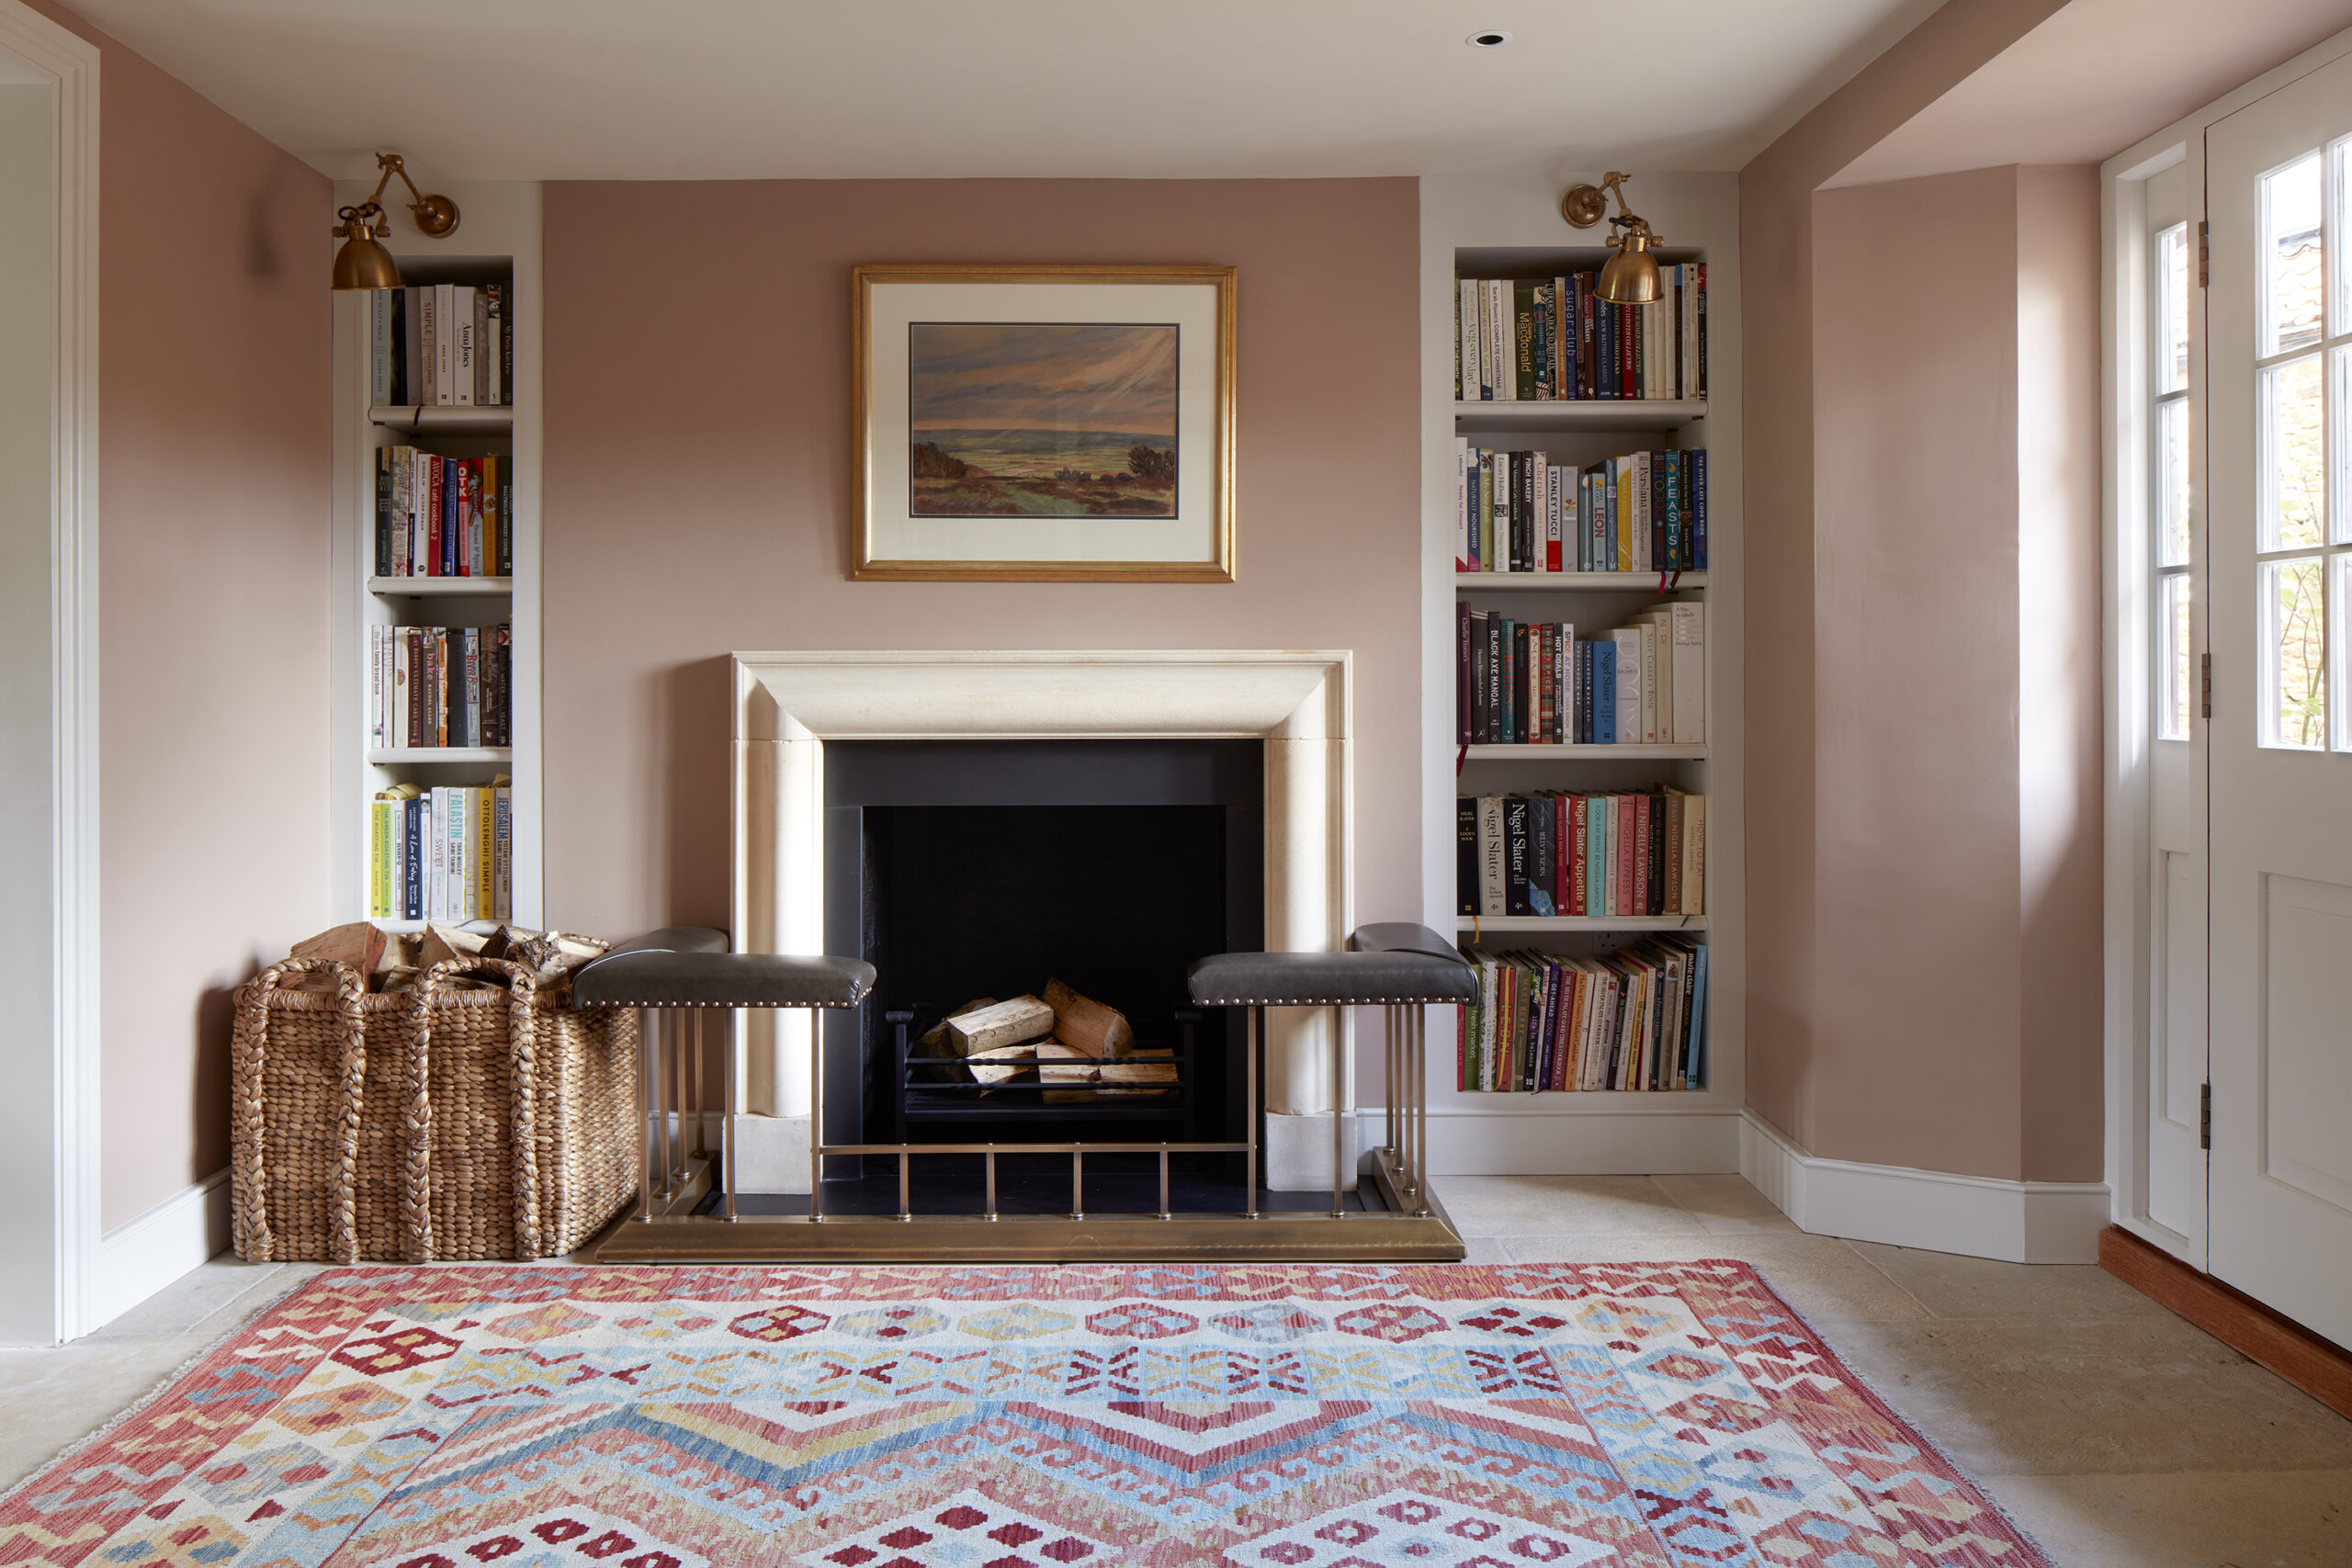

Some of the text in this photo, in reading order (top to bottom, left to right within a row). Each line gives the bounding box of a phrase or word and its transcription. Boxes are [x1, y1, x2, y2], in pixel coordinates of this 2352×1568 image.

[424, 302, 432, 337] SIMPLE
[1466, 323, 1476, 343] veg
[1565, 290, 1576, 356] sugar club
[461, 323, 472, 367] Anna Jones
[1468, 343, 1476, 367] every
[1520, 312, 1531, 372] Macdonald
[431, 461, 440, 486] AVOCA
[458, 467, 467, 497] OTK
[1497, 477, 1505, 503] Hollweg
[1640, 467, 1649, 508] Persiana
[1594, 508, 1604, 537] LEON
[1668, 477, 1678, 545] FEASTS
[466, 654, 477, 675] BAKER
[1503, 642, 1514, 705] GREENS
[1565, 656, 1571, 667] AT
[1601, 652, 1612, 701] Nigel Slater
[450, 794, 463, 838] FALASTIN
[498, 797, 509, 839] JERUSALEM
[1638, 816, 1646, 854] NIGELLA
[1509, 804, 1526, 873] Nigel Slater
[1575, 801, 1585, 902] Nigel Slater Appetite
[1697, 847, 1703, 858] TO
[1489, 841, 1501, 880] Slater
[1519, 978, 1529, 1034] MARY BERRY
[1549, 983, 1557, 1017] GET-AHEAD
